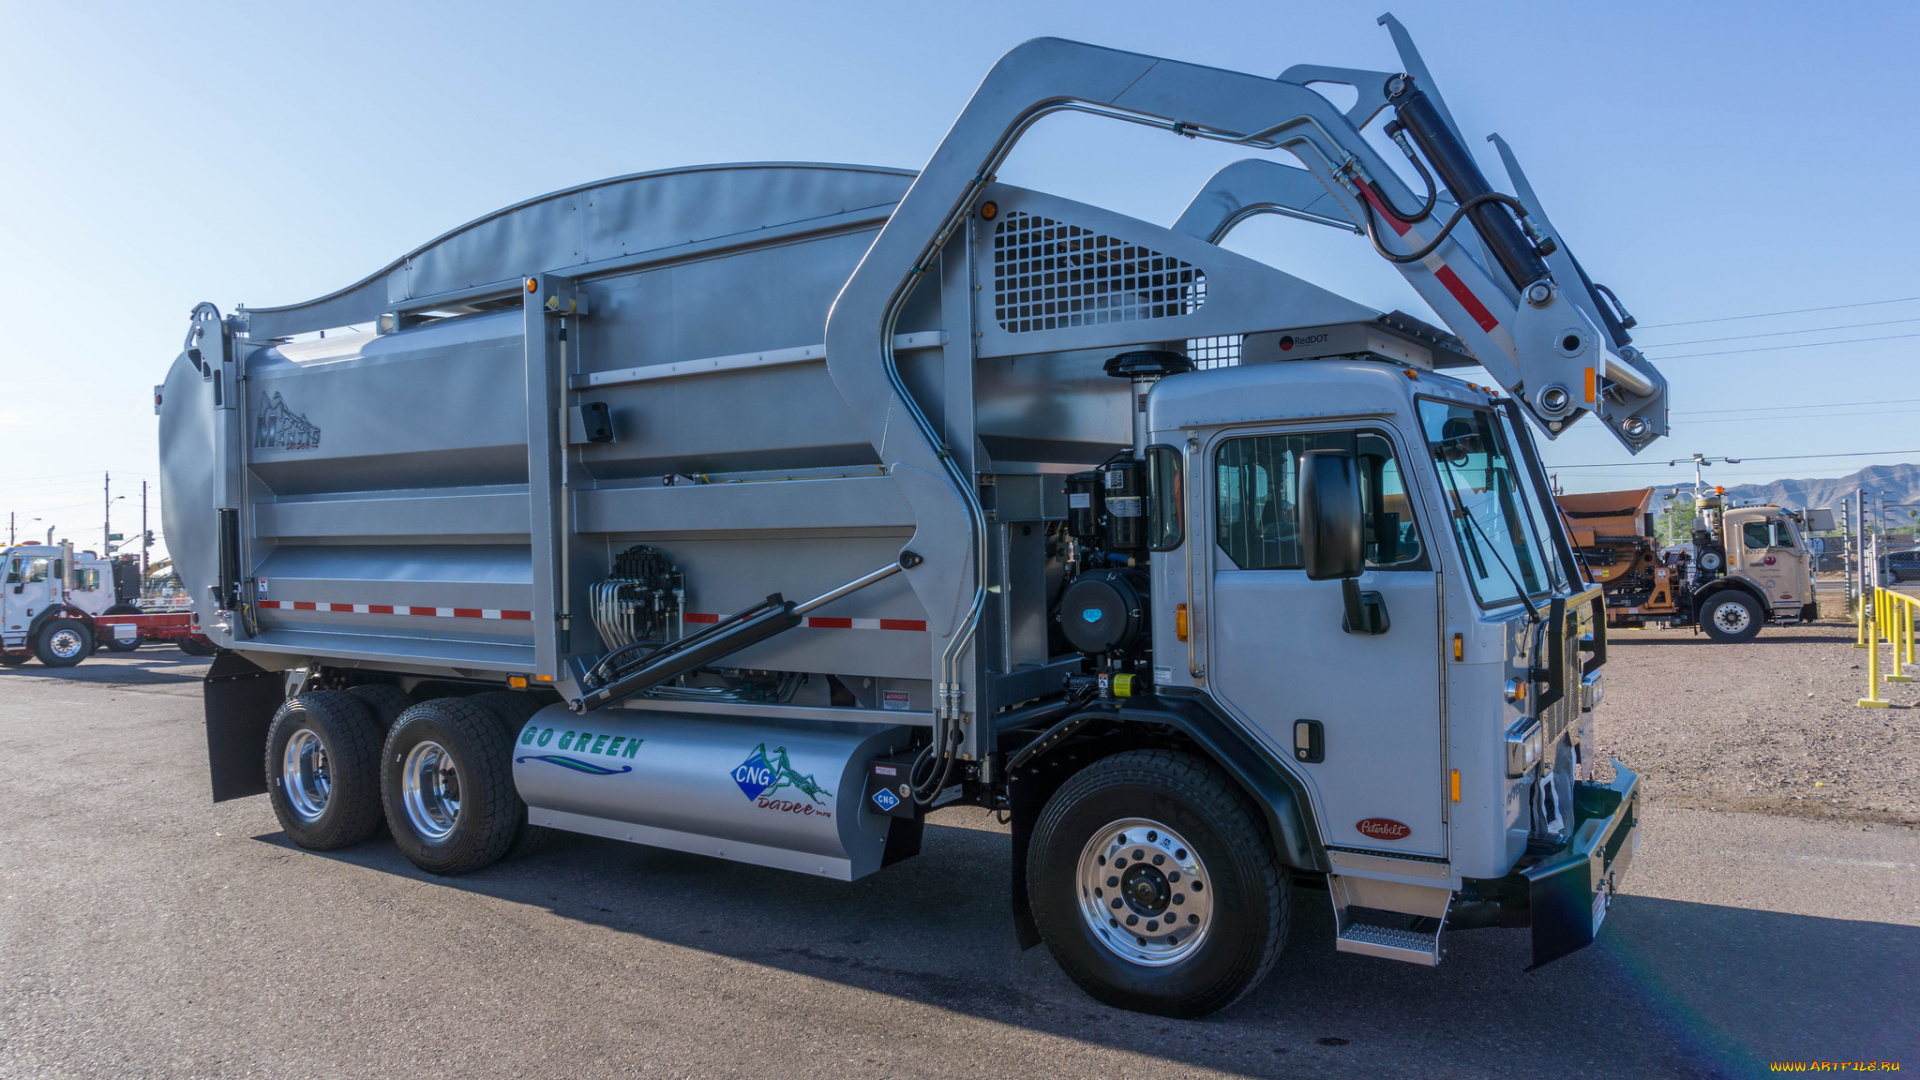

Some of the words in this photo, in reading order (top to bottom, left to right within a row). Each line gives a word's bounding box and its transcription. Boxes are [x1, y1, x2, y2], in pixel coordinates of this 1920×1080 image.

[1294, 334, 1328, 345] RedDOT
[520, 726, 554, 748] GO
[558, 730, 644, 759] GREEN
[735, 765, 771, 787] CNG
[877, 794, 895, 805] CNG
[1361, 820, 1407, 836] Peterbilt
